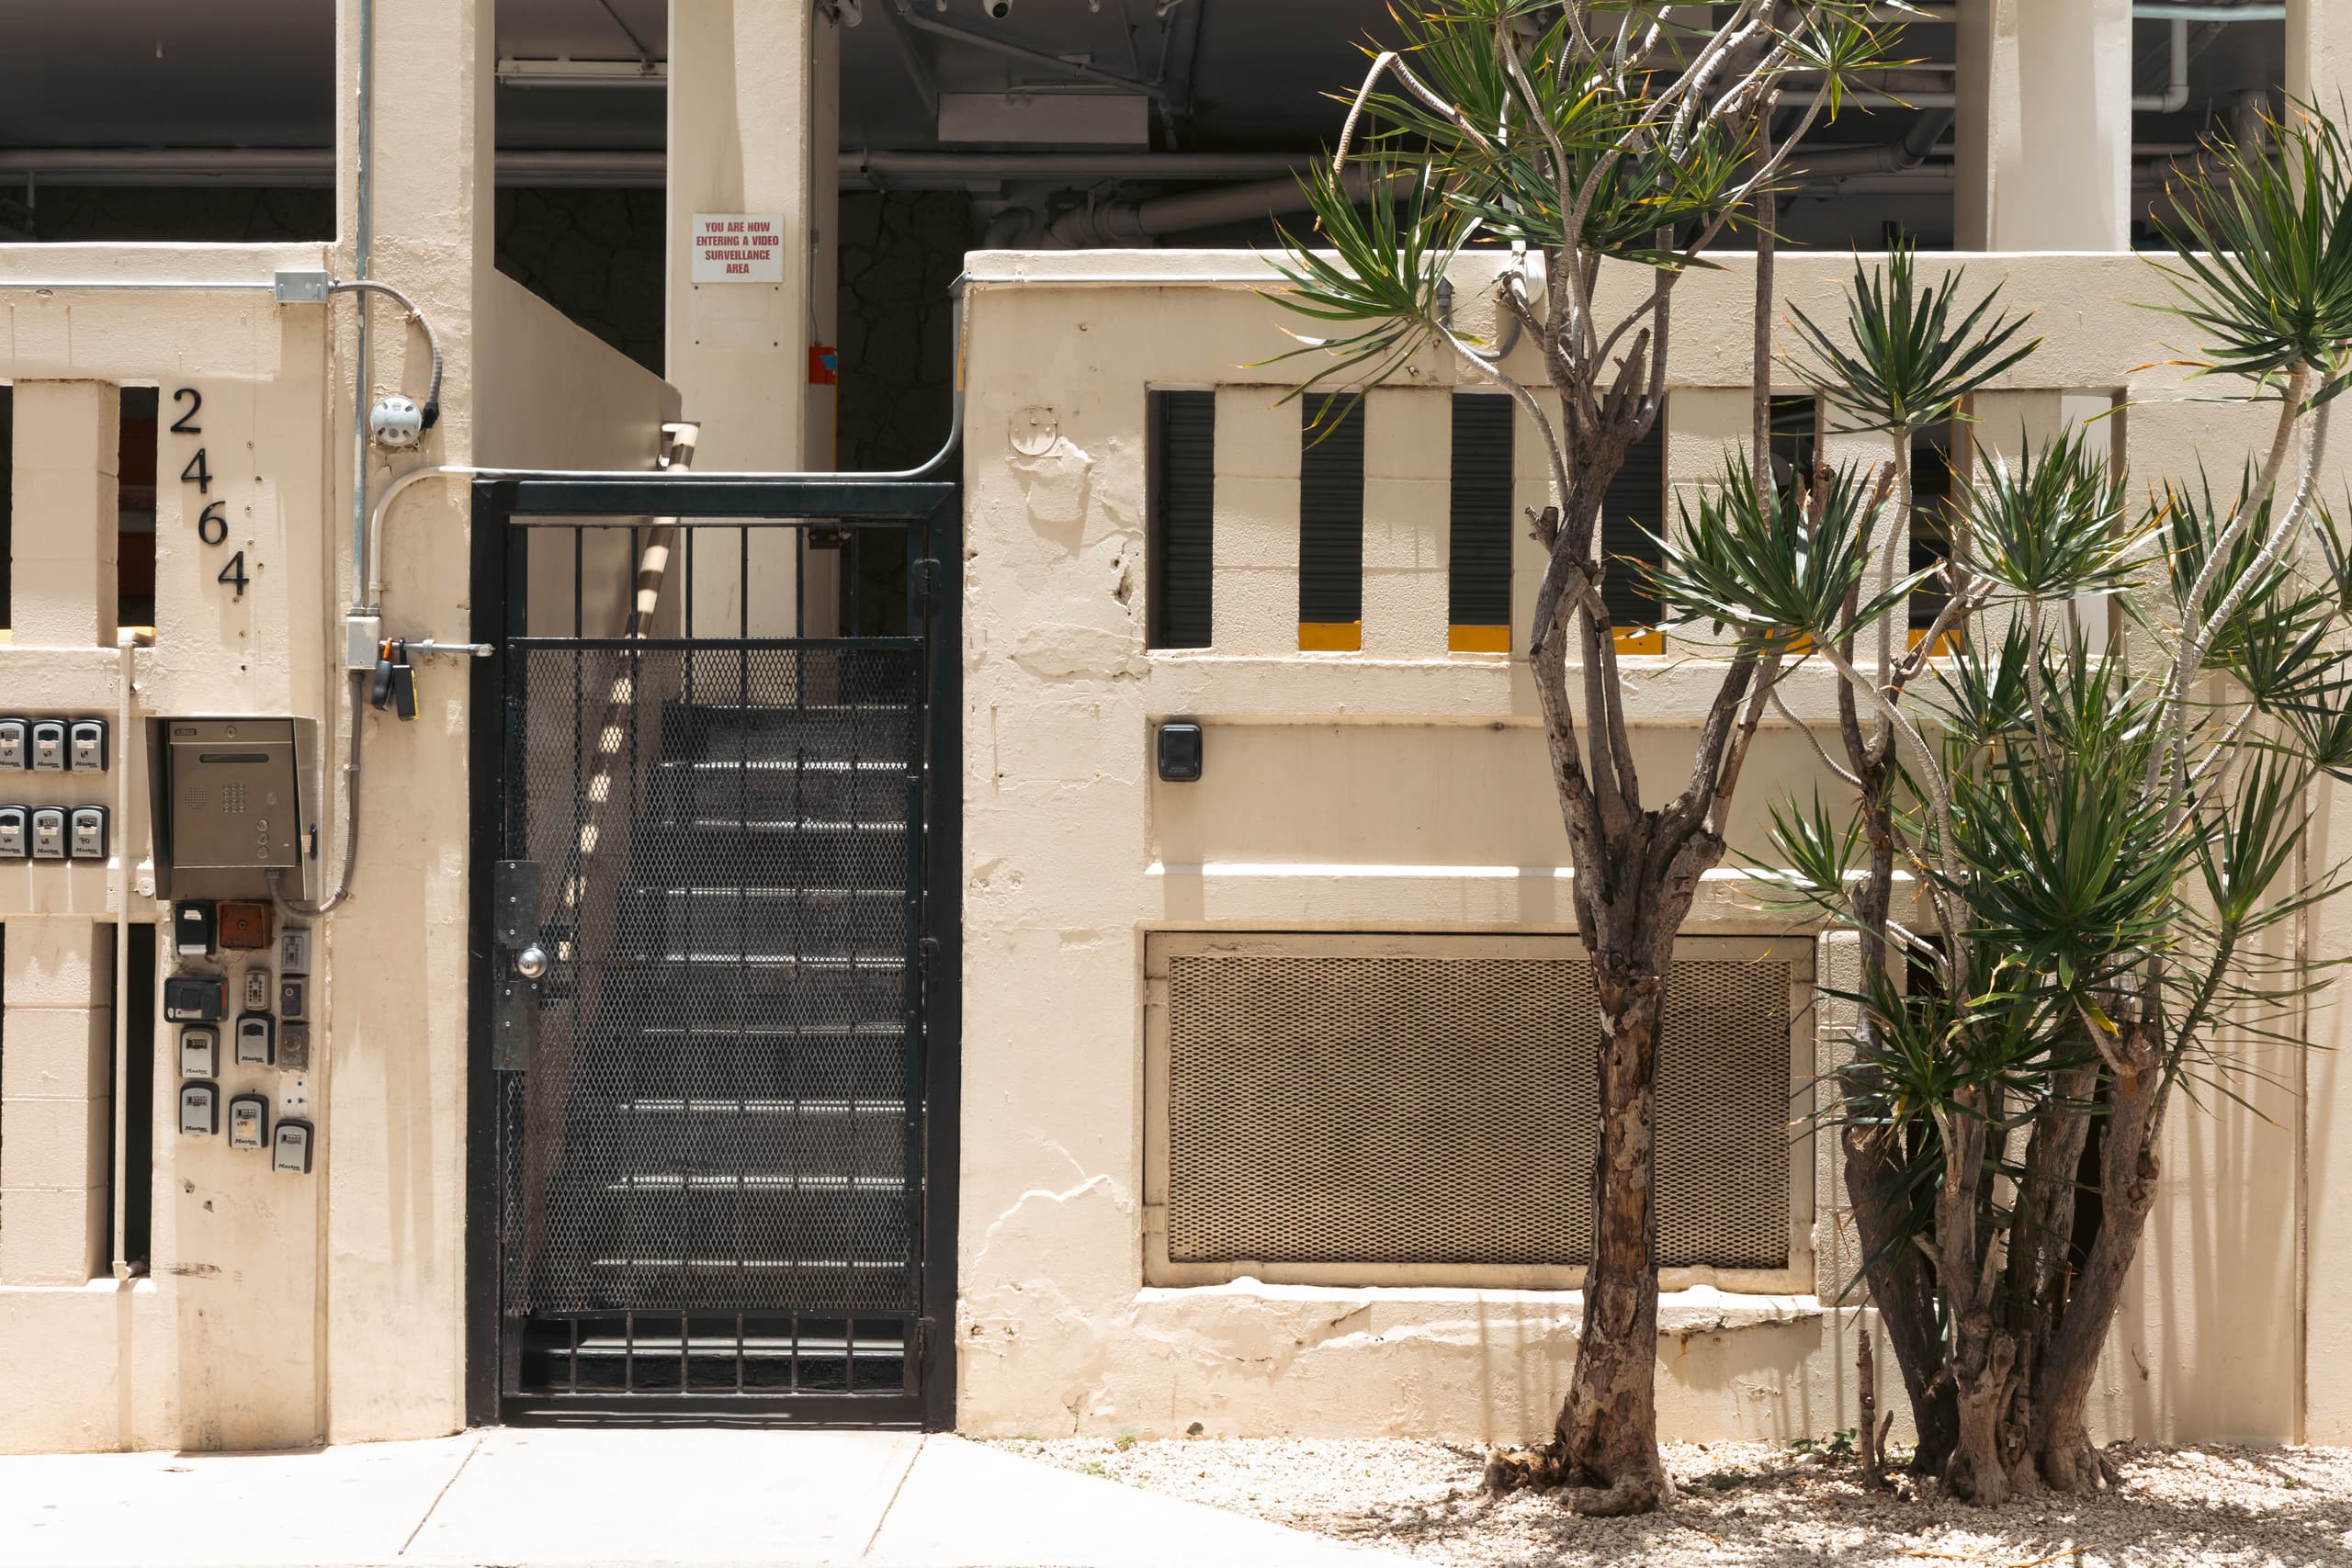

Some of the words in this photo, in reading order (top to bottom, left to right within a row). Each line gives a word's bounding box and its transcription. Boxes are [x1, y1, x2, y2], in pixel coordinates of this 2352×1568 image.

[706, 222, 724, 232] YOU
[728, 222, 745, 232] ARE
[748, 222, 770, 232] NOW
[696, 236, 740, 246] ENTERING
[742, 236, 749, 246] A
[752, 235, 779, 246] VIDEO
[706, 250, 770, 260] SURVEILLANCE
[726, 264, 750, 274] AREA
[170, 389, 250, 596] 2464
[79, 837, 90, 845] 70
